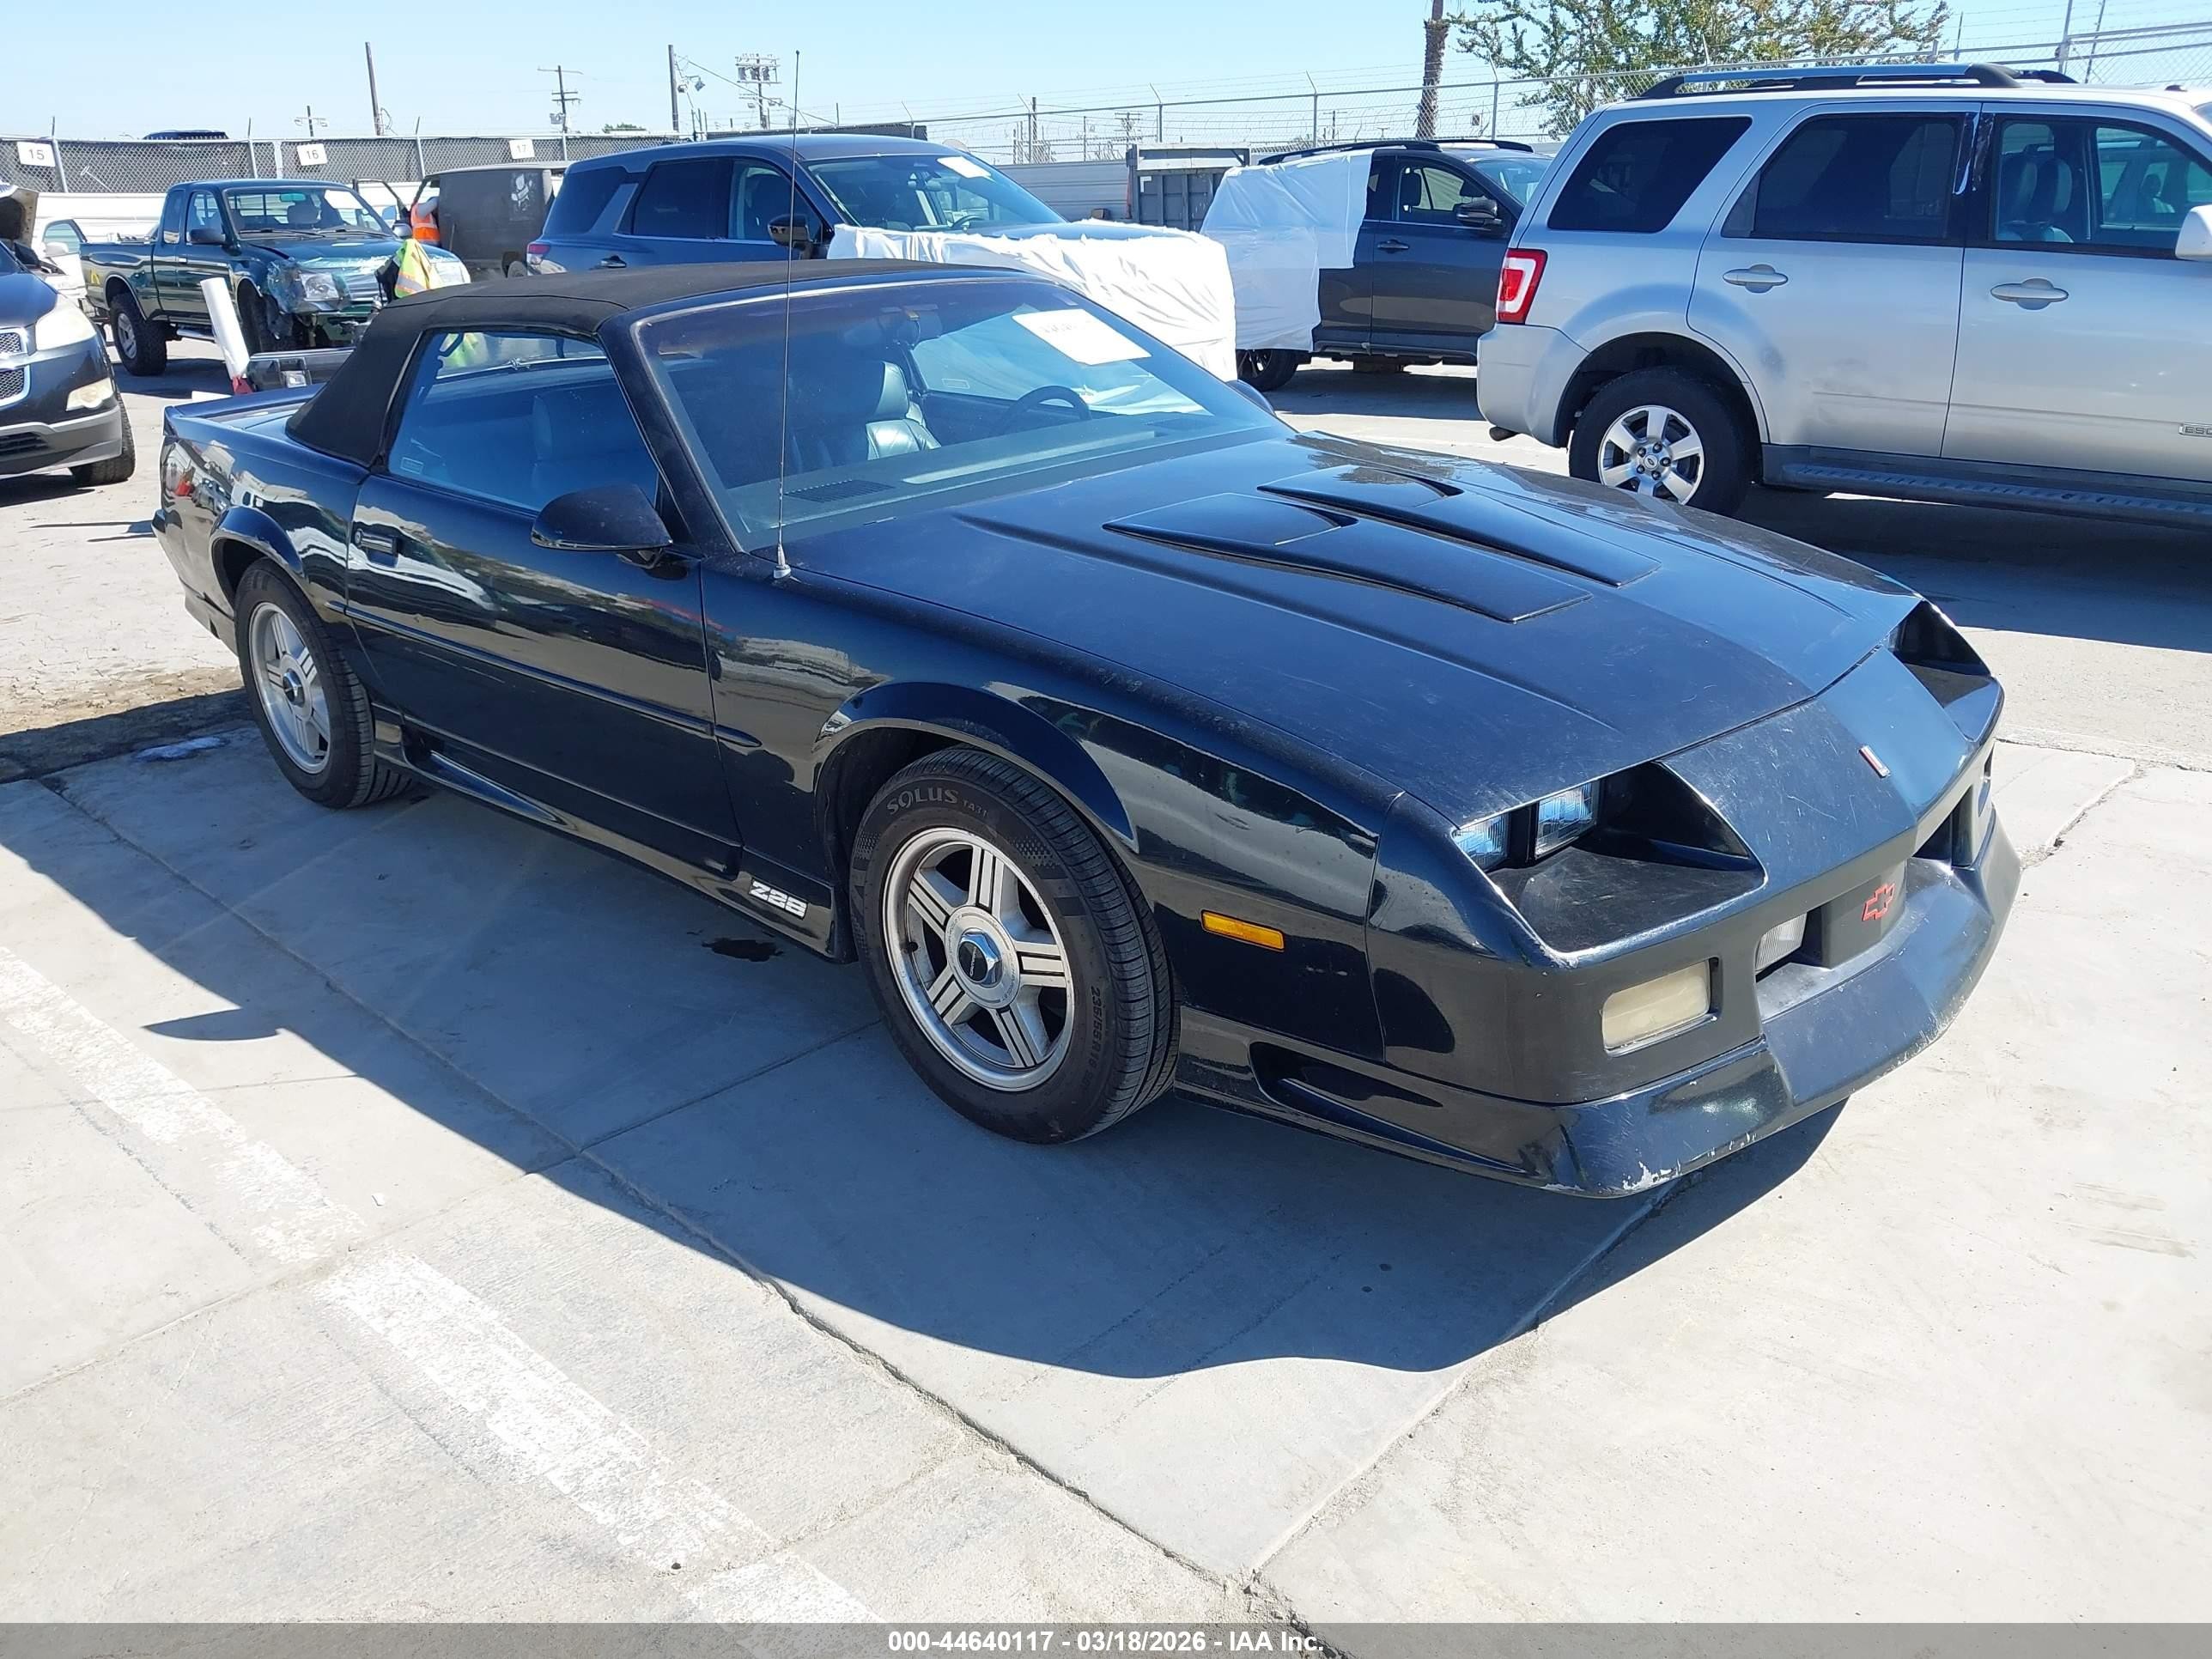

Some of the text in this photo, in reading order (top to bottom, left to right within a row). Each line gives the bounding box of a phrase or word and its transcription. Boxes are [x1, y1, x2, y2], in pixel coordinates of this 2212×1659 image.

[28, 148, 45, 161] 15
[306, 149, 319, 160] 16
[886, 787, 959, 815] SOLUS
[749, 880, 807, 919] Z28
